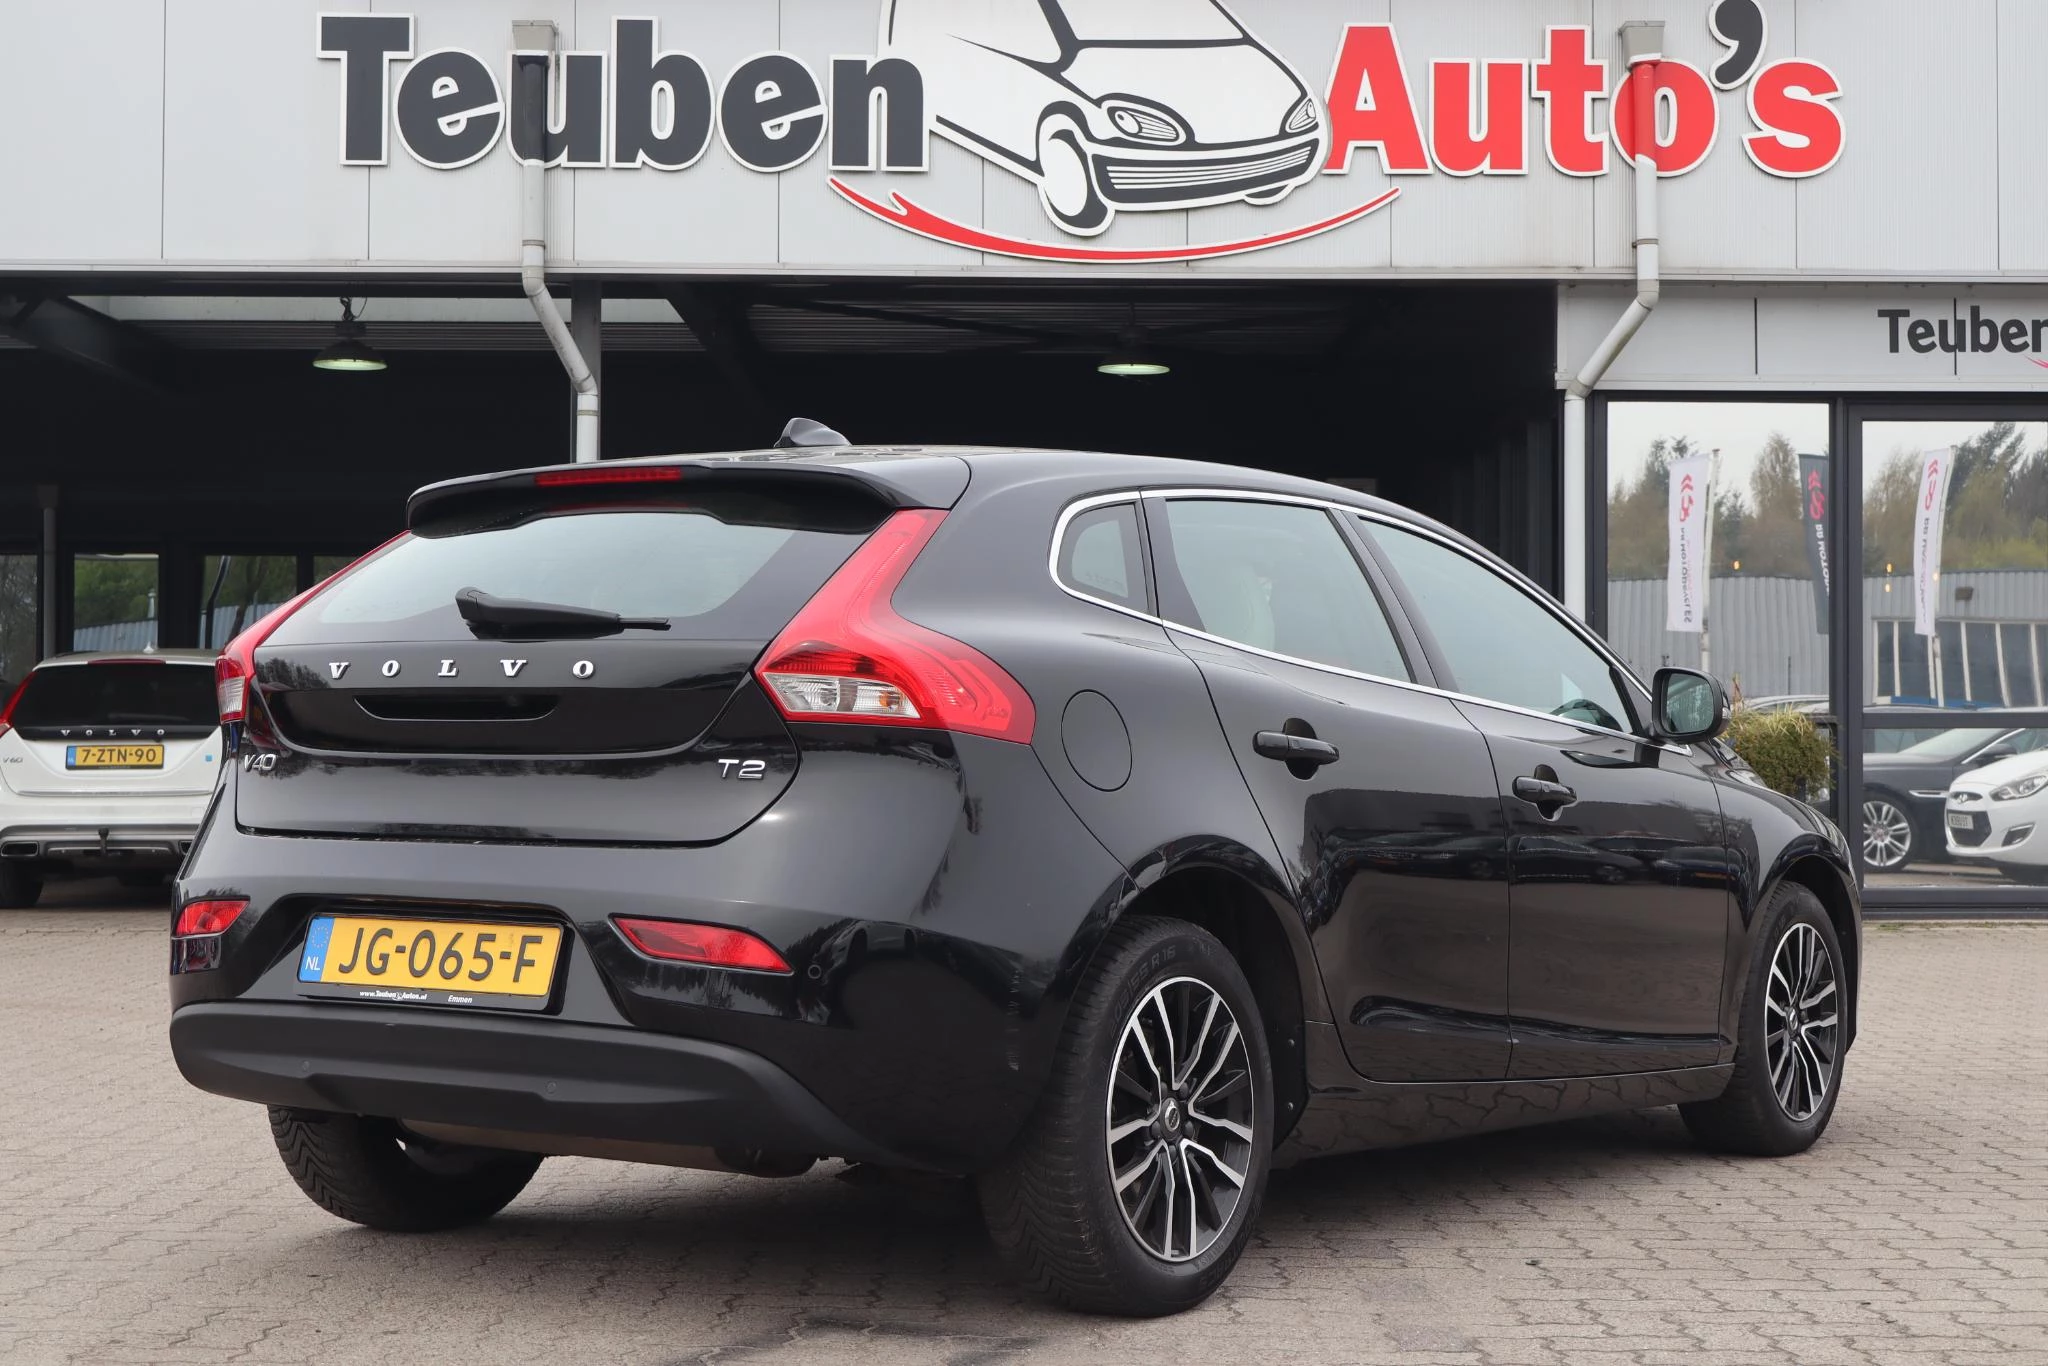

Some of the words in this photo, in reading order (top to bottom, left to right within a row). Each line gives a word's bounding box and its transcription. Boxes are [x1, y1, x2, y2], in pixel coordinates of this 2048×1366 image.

[317, 13, 929, 171] Teuben
[1324, 0, 1845, 177] Auto's
[329, 659, 595, 680] VOLVO
[82, 748, 157, 763] 7-ZTN-90
[244, 753, 277, 771] V40
[718, 758, 766, 779] T2
[305, 956, 320, 971] NL
[338, 927, 543, 982] JG-065-F
[448, 994, 473, 1004] Emmen
